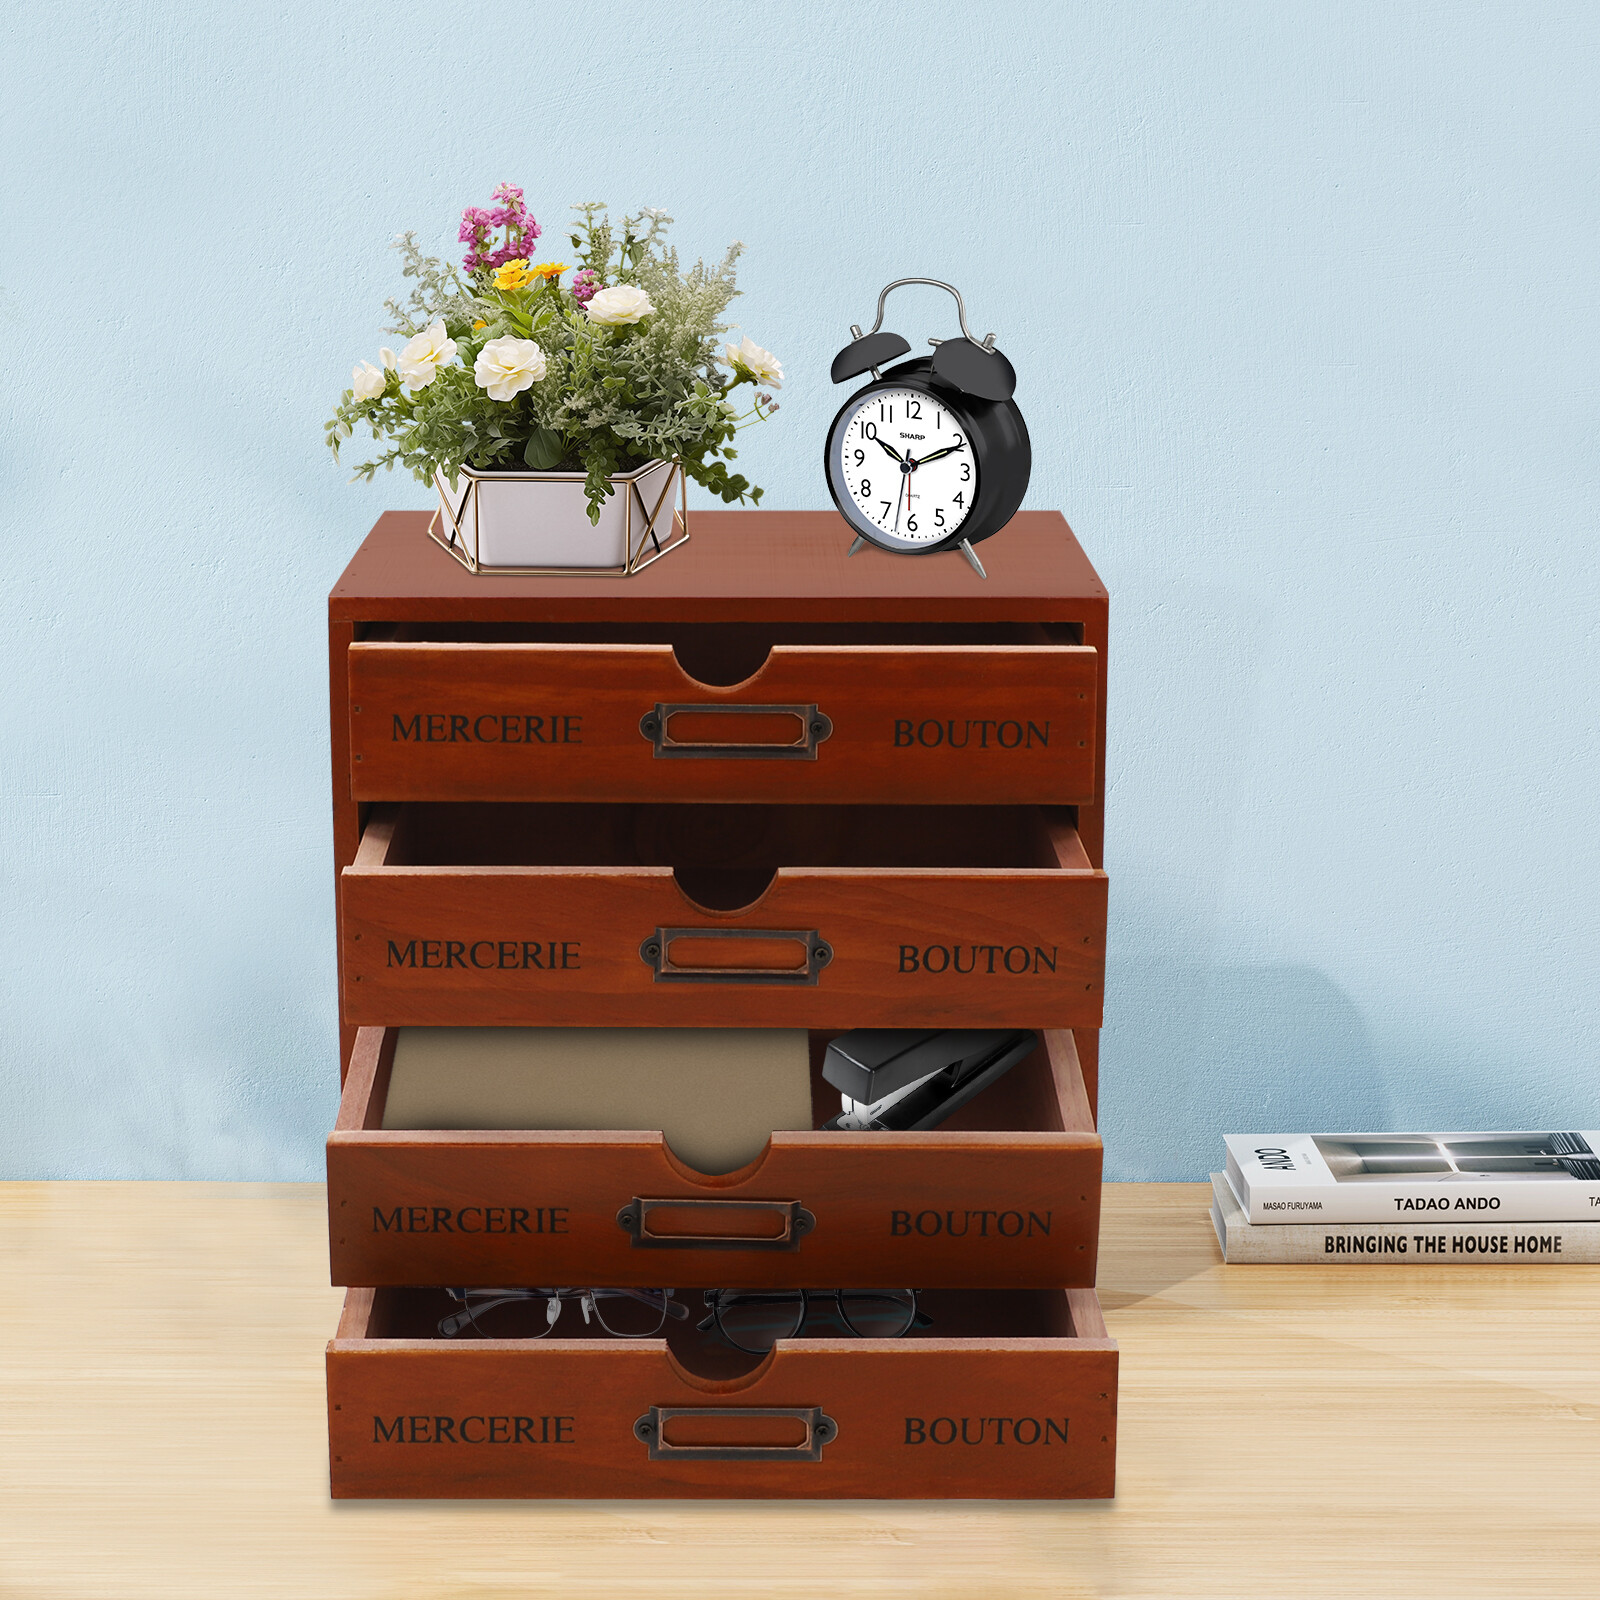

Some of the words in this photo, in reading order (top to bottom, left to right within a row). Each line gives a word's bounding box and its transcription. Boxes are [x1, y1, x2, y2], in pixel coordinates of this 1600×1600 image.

[880, 403, 893, 424] 11
[906, 400, 923, 420] 12
[860, 420, 877, 441] 10
[899, 432, 926, 441] SHARP
[952, 433, 966, 452] 2
[854, 448, 865, 468] 9
[960, 462, 971, 482] 3
[860, 478, 872, 498] 8
[880, 500, 892, 520] 7
[952, 491, 965, 510] 4
[907, 513, 918, 532] 6
[934, 508, 945, 527] 5
[392, 714, 583, 743] MERCERIE
[893, 719, 1051, 749] BOUTON
[387, 940, 580, 970] MERCERIE
[898, 945, 1058, 974] BOUTON
[1254, 1148, 1296, 1171] ANDO
[1263, 1202, 1286, 1211] MASAO
[1287, 1202, 1323, 1210] FURUYAMA
[1394, 1197, 1450, 1211] TADAO
[1454, 1197, 1501, 1210] ANDO
[373, 1206, 570, 1234] MERCERIE
[890, 1210, 1052, 1238] BOUTON
[1325, 1236, 1407, 1254] BRINGING
[1413, 1236, 1446, 1253] THE
[1452, 1236, 1508, 1254] HOUSE
[1514, 1236, 1562, 1253] HOME
[373, 1416, 575, 1444] MERCERIE
[904, 1417, 1069, 1446] BOUTON
